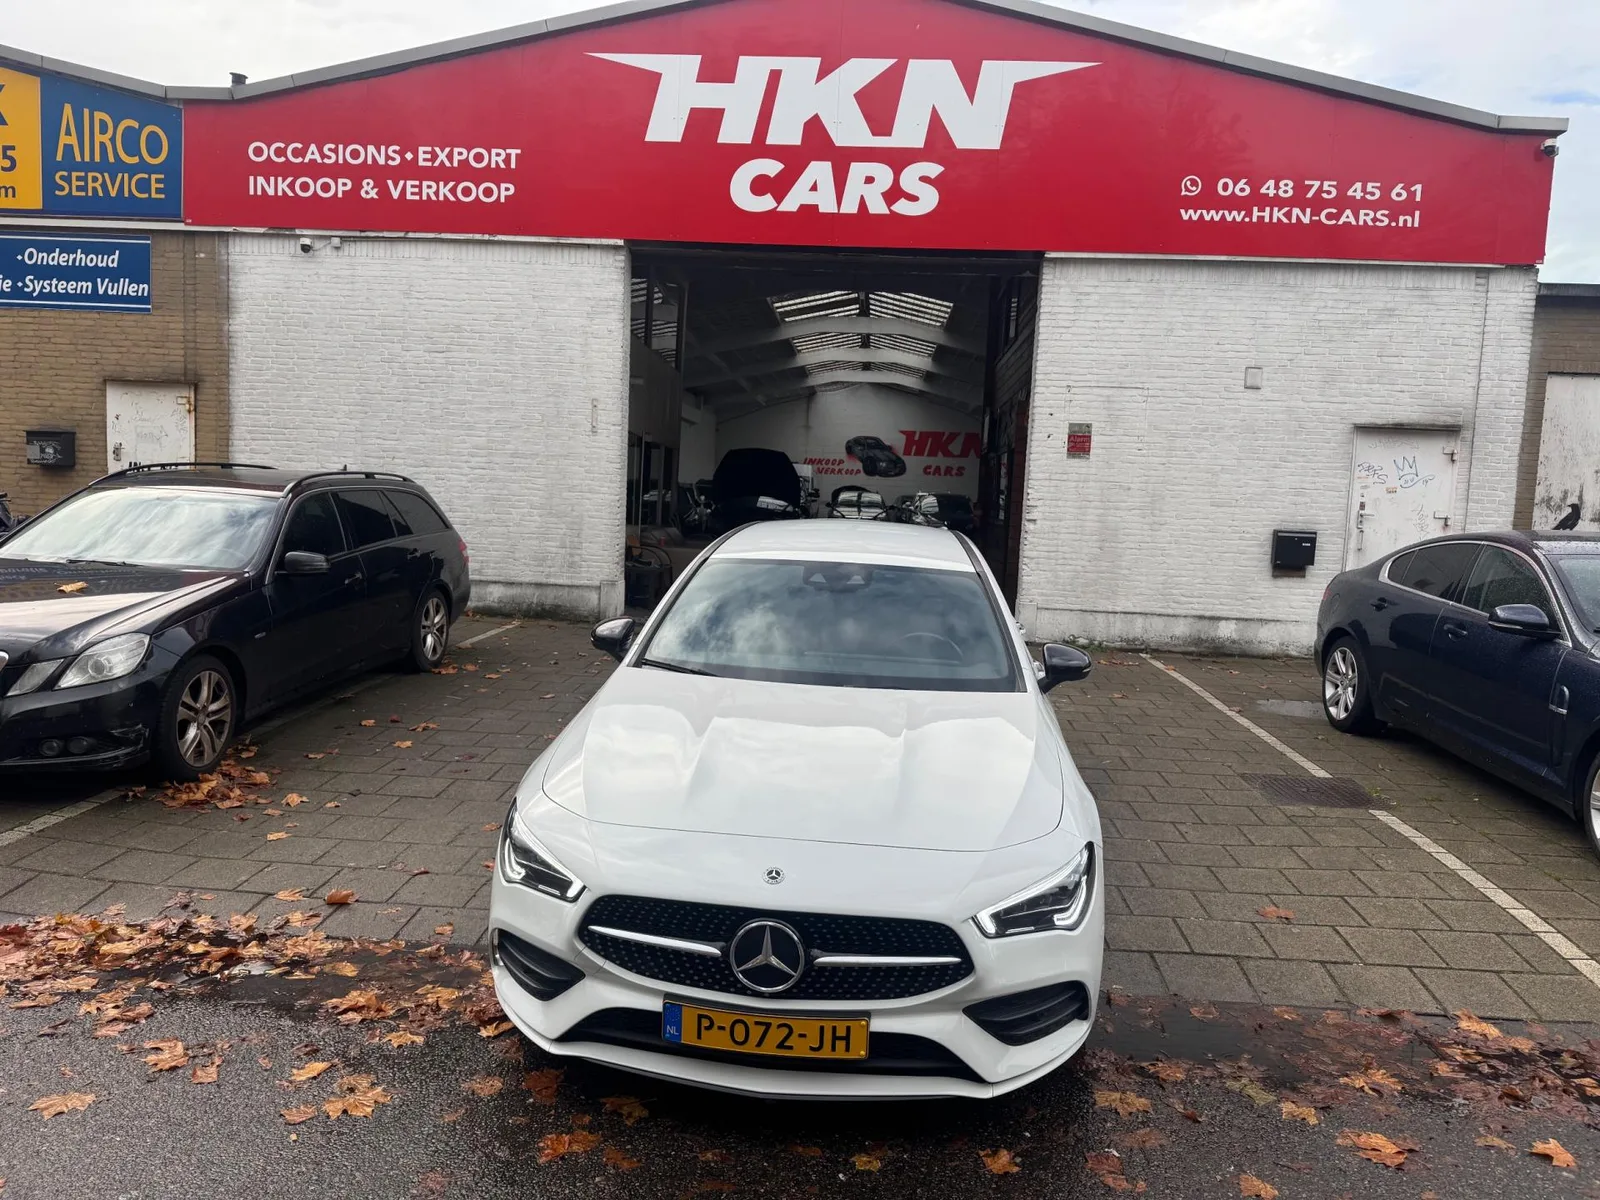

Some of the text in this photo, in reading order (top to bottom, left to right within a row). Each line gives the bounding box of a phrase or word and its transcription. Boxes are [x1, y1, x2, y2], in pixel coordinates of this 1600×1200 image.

[583, 52, 1103, 150] HKN
[56, 103, 169, 165] AIRCO
[248, 141, 521, 169] OCCASIONS EXPORT
[55, 171, 165, 199] SERVICE
[248, 175, 515, 203] INKOOP & VERKOOP
[729, 158, 945, 216] CARS
[1217, 177, 1423, 202] 06 48 75 45 61
[1180, 206, 1420, 228] www.HKN-CARS.nl
[23, 247, 120, 268] Onderhoud
[23, 275, 92, 297] Systeem
[97, 278, 149, 297] Vullen
[803, 457, 845, 466] INKOOP
[816, 467, 862, 476] VERKOOP
[923, 464, 967, 478] CARS
[666, 1025, 679, 1036] NL
[696, 1013, 851, 1053] P-072-JH
